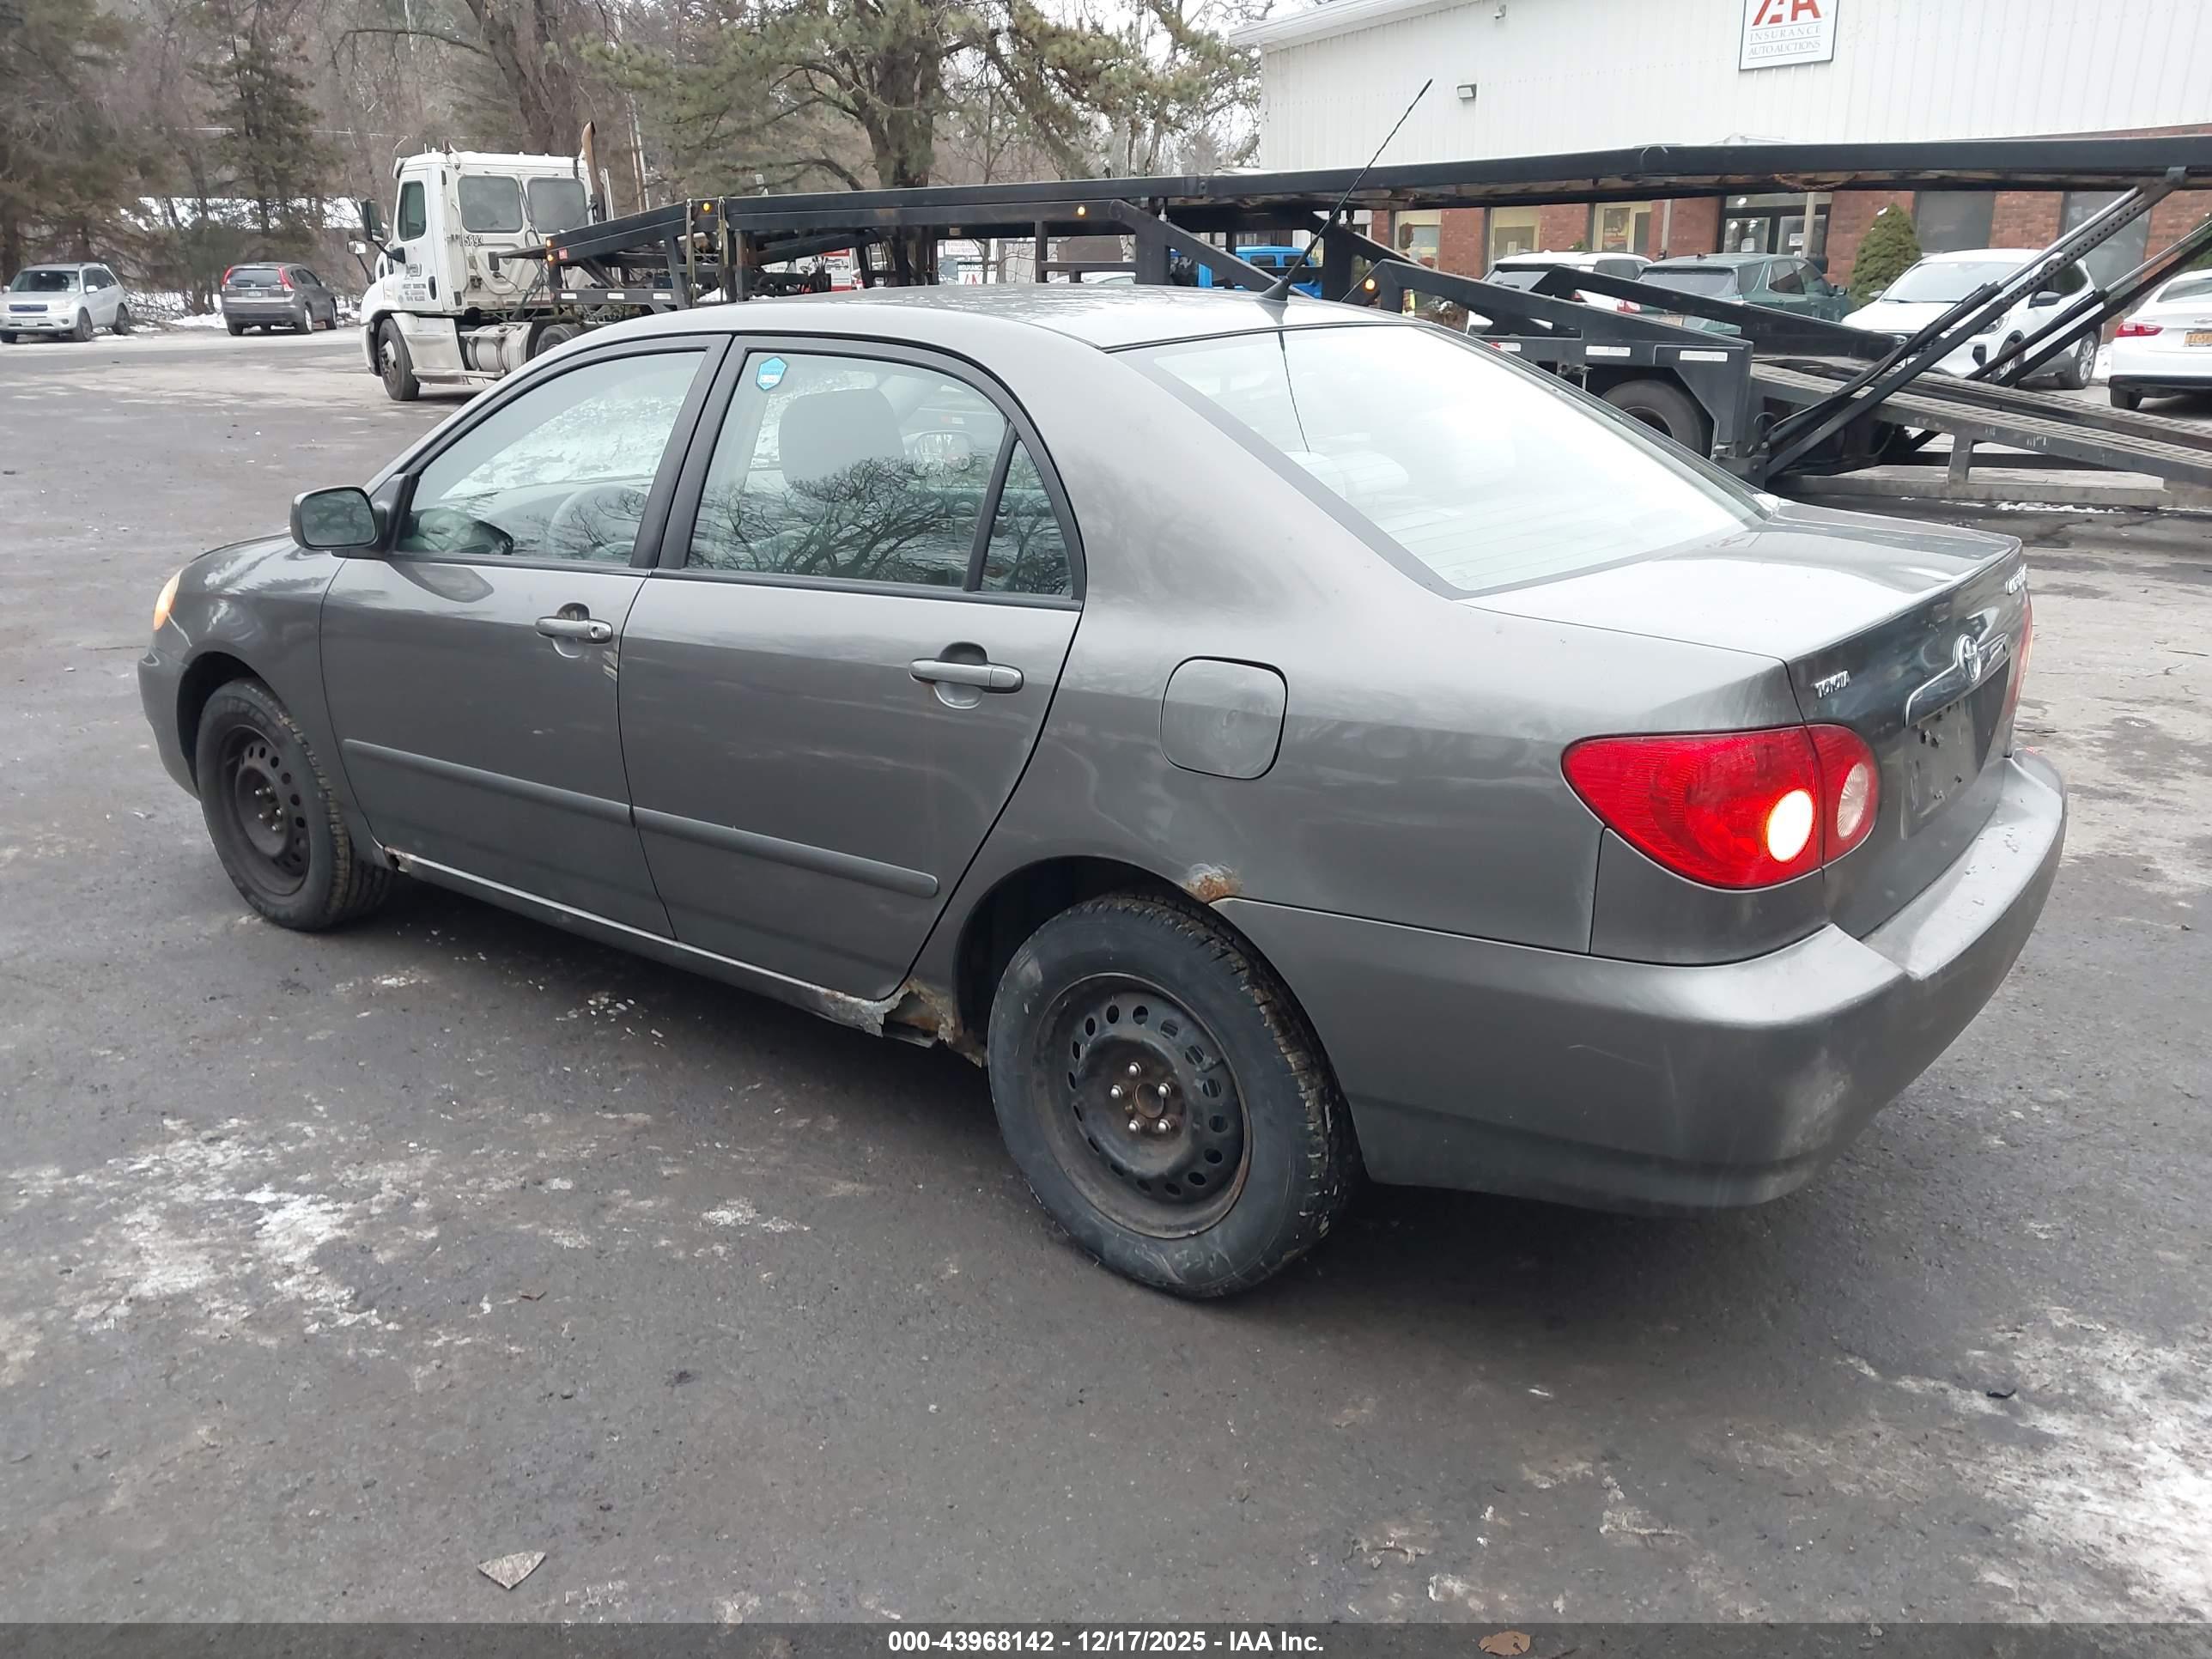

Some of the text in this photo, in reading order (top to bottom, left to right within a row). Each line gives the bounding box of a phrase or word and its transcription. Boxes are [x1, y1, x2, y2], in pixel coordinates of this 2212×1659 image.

[1750, 25, 1821, 42] INSURANCE
[1748, 40, 1821, 56] AUTO AUCTIONS
[1814, 670, 1850, 698] TOYOTA
